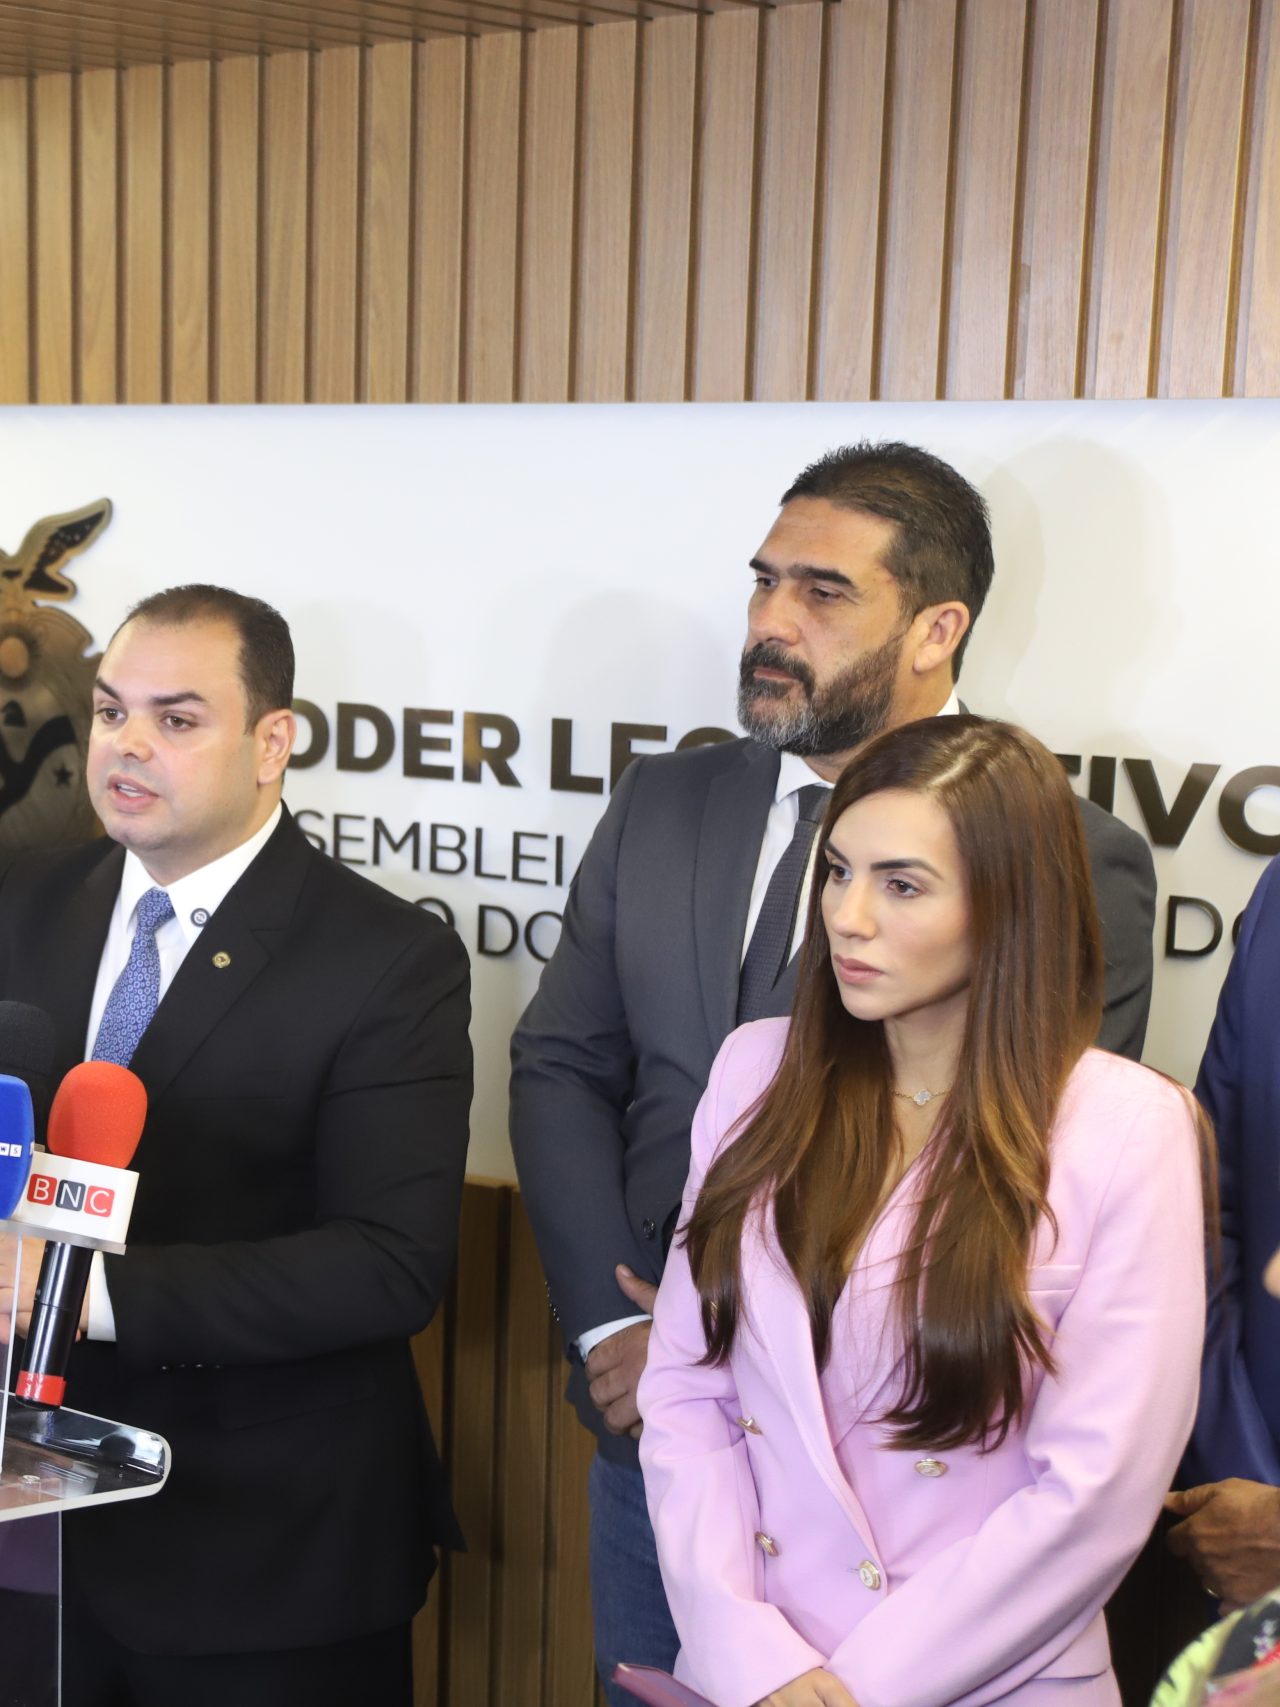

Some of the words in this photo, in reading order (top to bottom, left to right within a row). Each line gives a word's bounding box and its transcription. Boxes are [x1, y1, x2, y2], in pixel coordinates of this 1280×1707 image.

[285, 697, 521, 788] ODER
[293, 809, 582, 888] SEMBLEI
[31, 1177, 111, 1215] BNC
